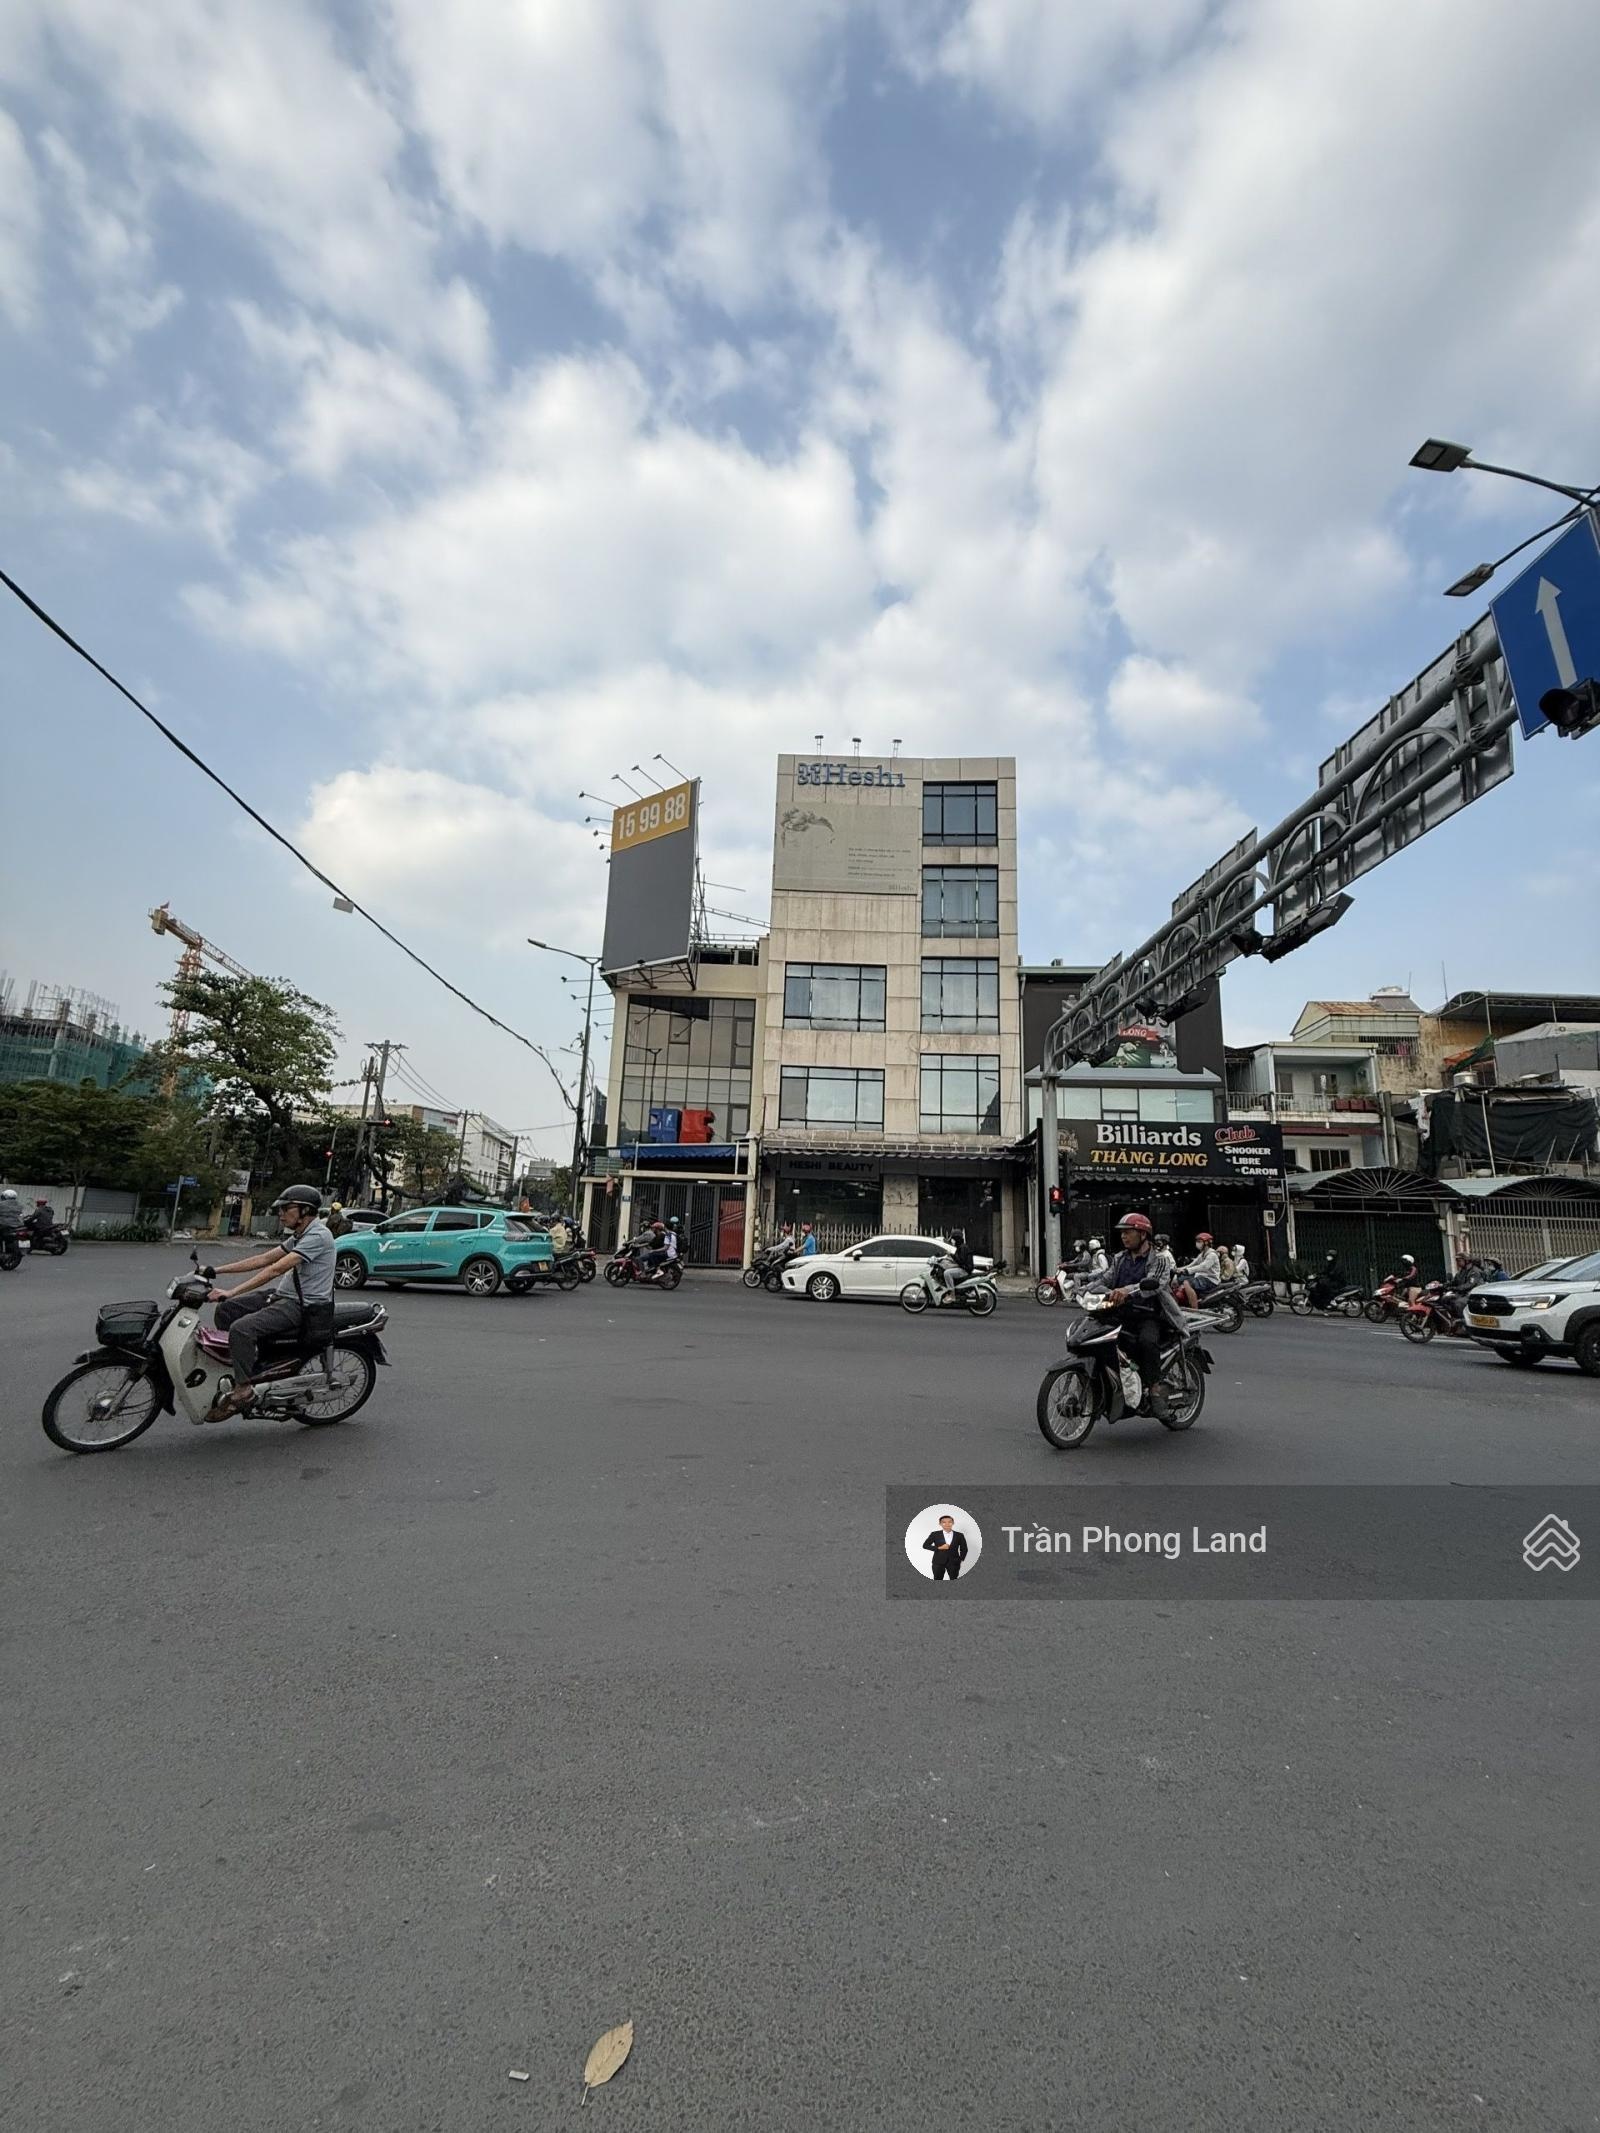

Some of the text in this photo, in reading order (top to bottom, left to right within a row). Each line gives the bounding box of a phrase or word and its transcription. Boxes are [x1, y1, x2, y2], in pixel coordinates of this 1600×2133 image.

[823, 763, 906, 788] Heshi
[618, 792, 686, 840] 15 99 88
[1097, 1123, 1202, 1147] Billiards
[1214, 1124, 1256, 1142] Club
[1091, 1148, 1208, 1167] THĂNG LONG
[1223, 1145, 1271, 1155] SNOOKER
[789, 1160, 874, 1172] HESHI BEAUTY
[1241, 1166, 1278, 1176] CAROM
